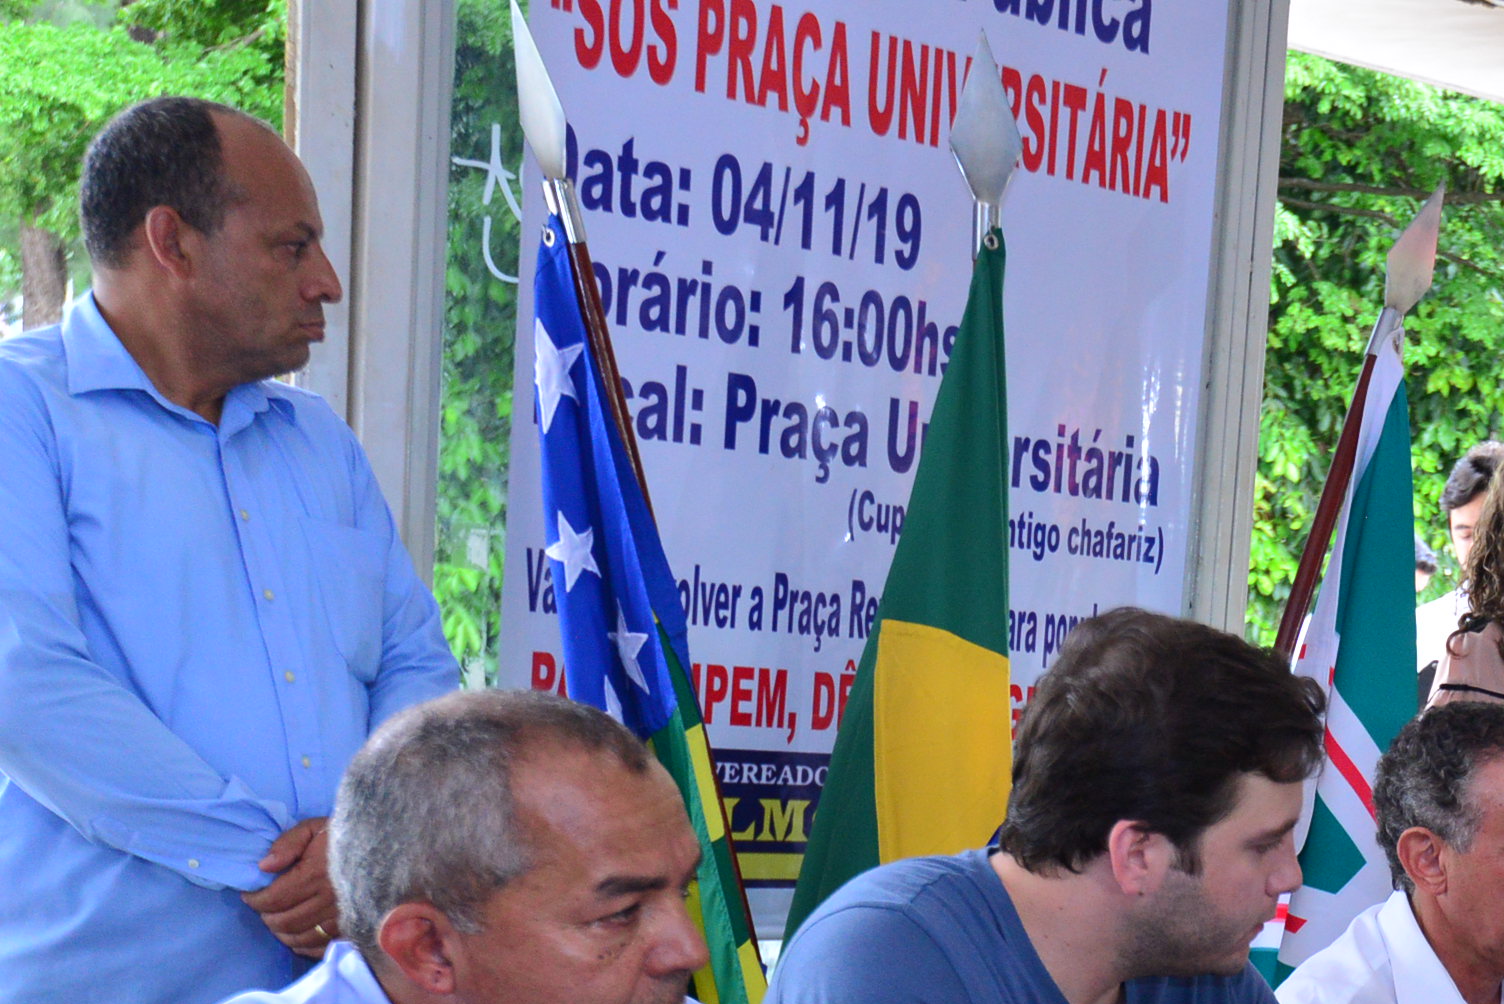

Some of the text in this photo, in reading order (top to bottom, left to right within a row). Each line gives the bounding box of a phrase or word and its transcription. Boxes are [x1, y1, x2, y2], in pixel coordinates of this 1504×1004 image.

[551, 0, 1192, 204] SOS PRAÇA UNIVRSITÁRIA”
[711, 153, 923, 271] 04/11/19
[590, 250, 762, 347] orário:
[723, 371, 869, 484] Praça
[1067, 517, 1164, 575] chafariz)
[749, 584, 764, 632] a
[771, 572, 841, 652] Praça
[1009, 609, 1038, 654] ara
[715, 761, 830, 787] VEREADO
